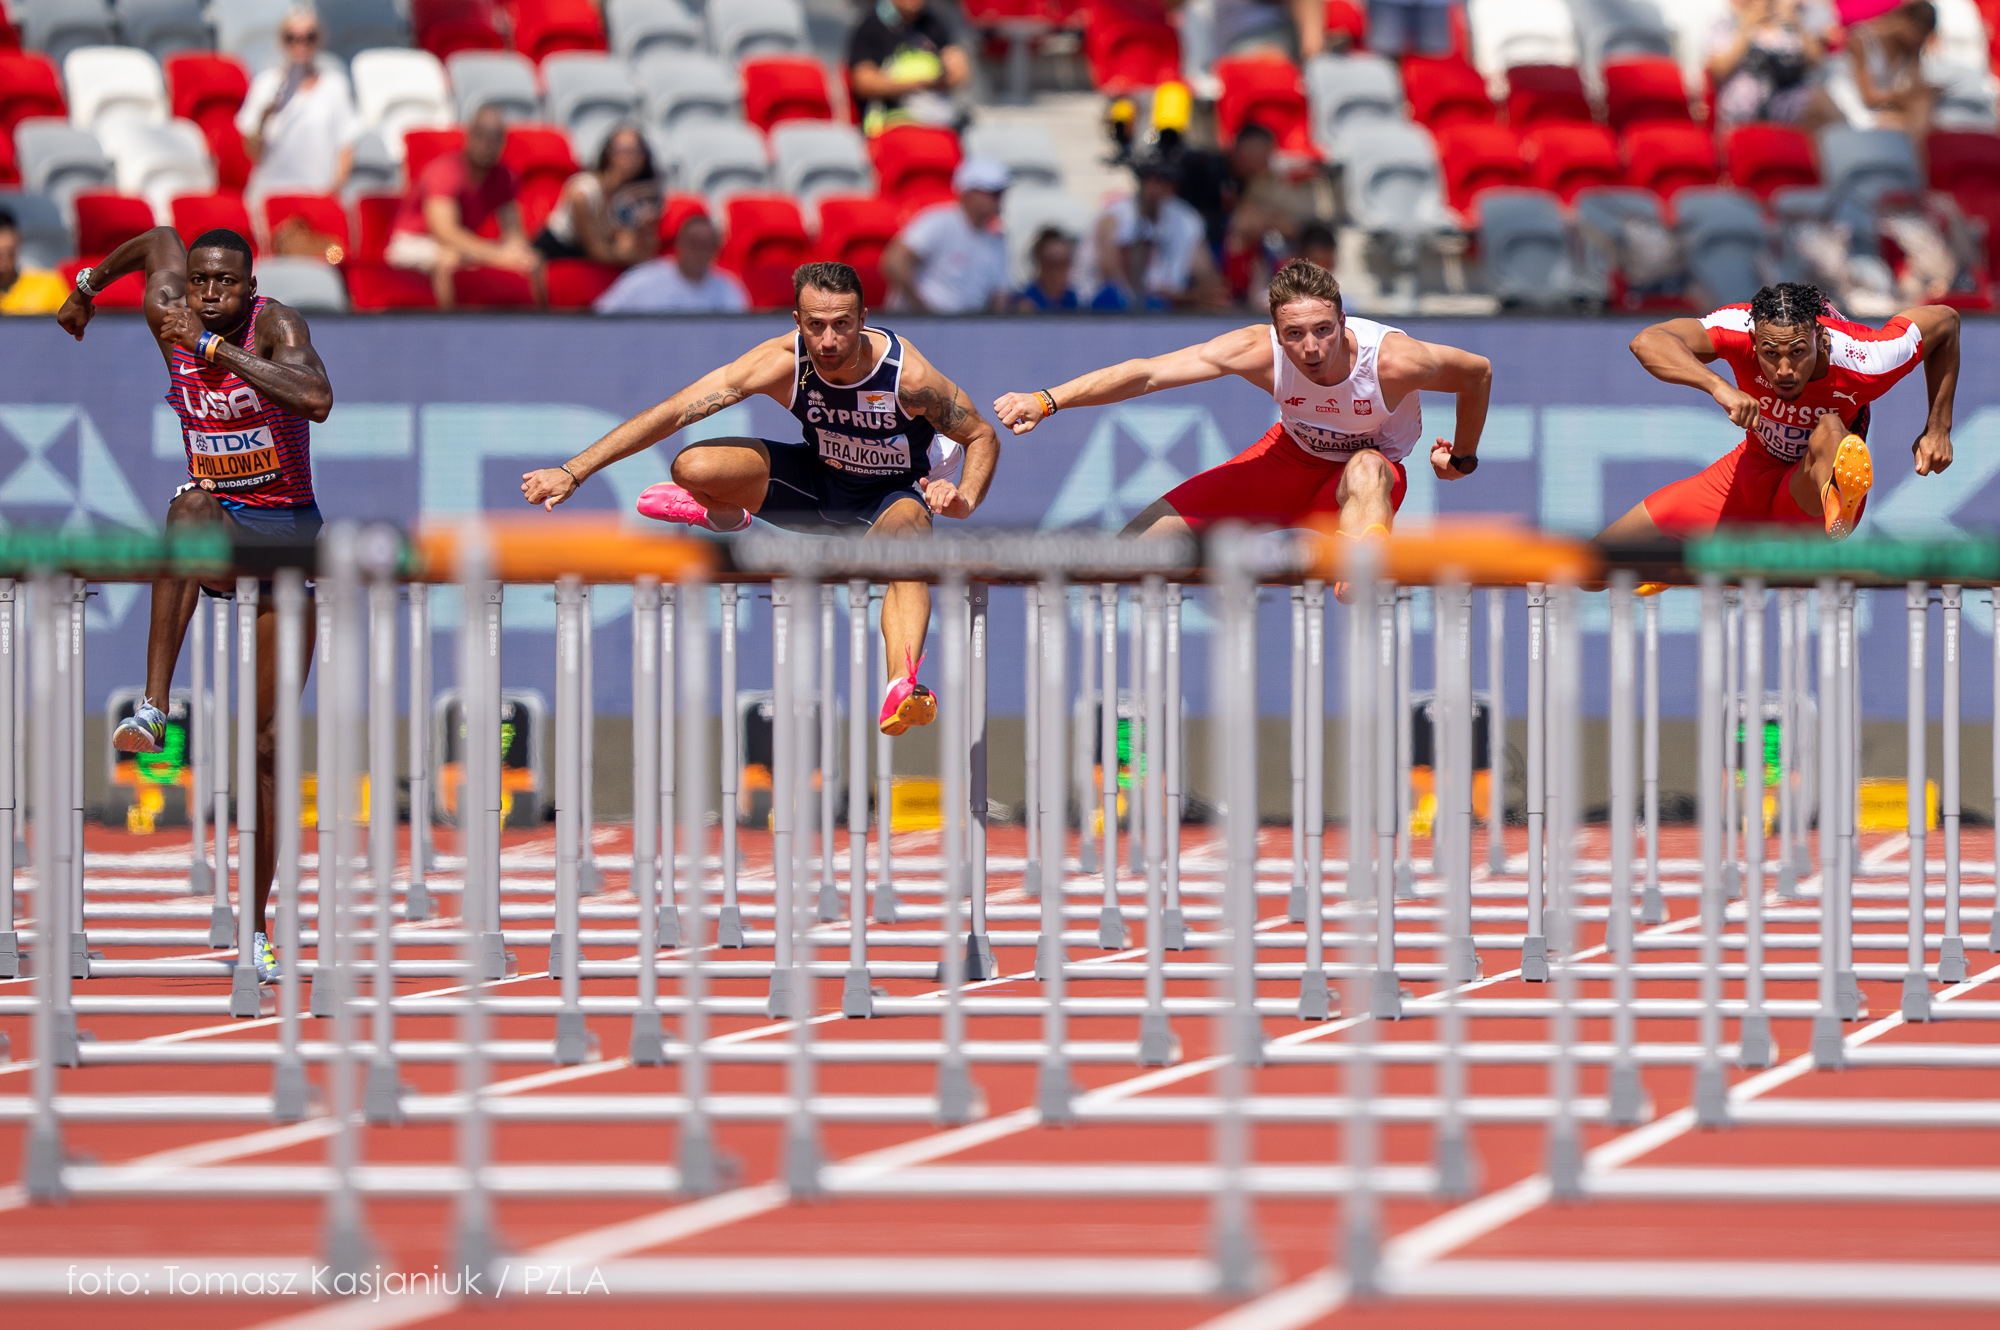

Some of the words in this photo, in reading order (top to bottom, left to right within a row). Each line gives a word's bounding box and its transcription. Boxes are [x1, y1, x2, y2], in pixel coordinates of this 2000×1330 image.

[182, 386, 262, 420] USA
[806, 406, 897, 430] CYPRUS
[206, 429, 266, 453] TDK
[823, 440, 906, 466] TRAJKOVIC
[196, 449, 273, 476] HOLLOWAY
[845, 464, 893, 476] BUDAPEST
[217, 476, 264, 489] BUDAPEST
[72, 622, 81, 655] MONDO
[488, 624, 497, 656] MONDO
[974, 625, 983, 658] MONDO
[1532, 626, 1540, 660] MONDO
[1947, 628, 1956, 662] MONDO
